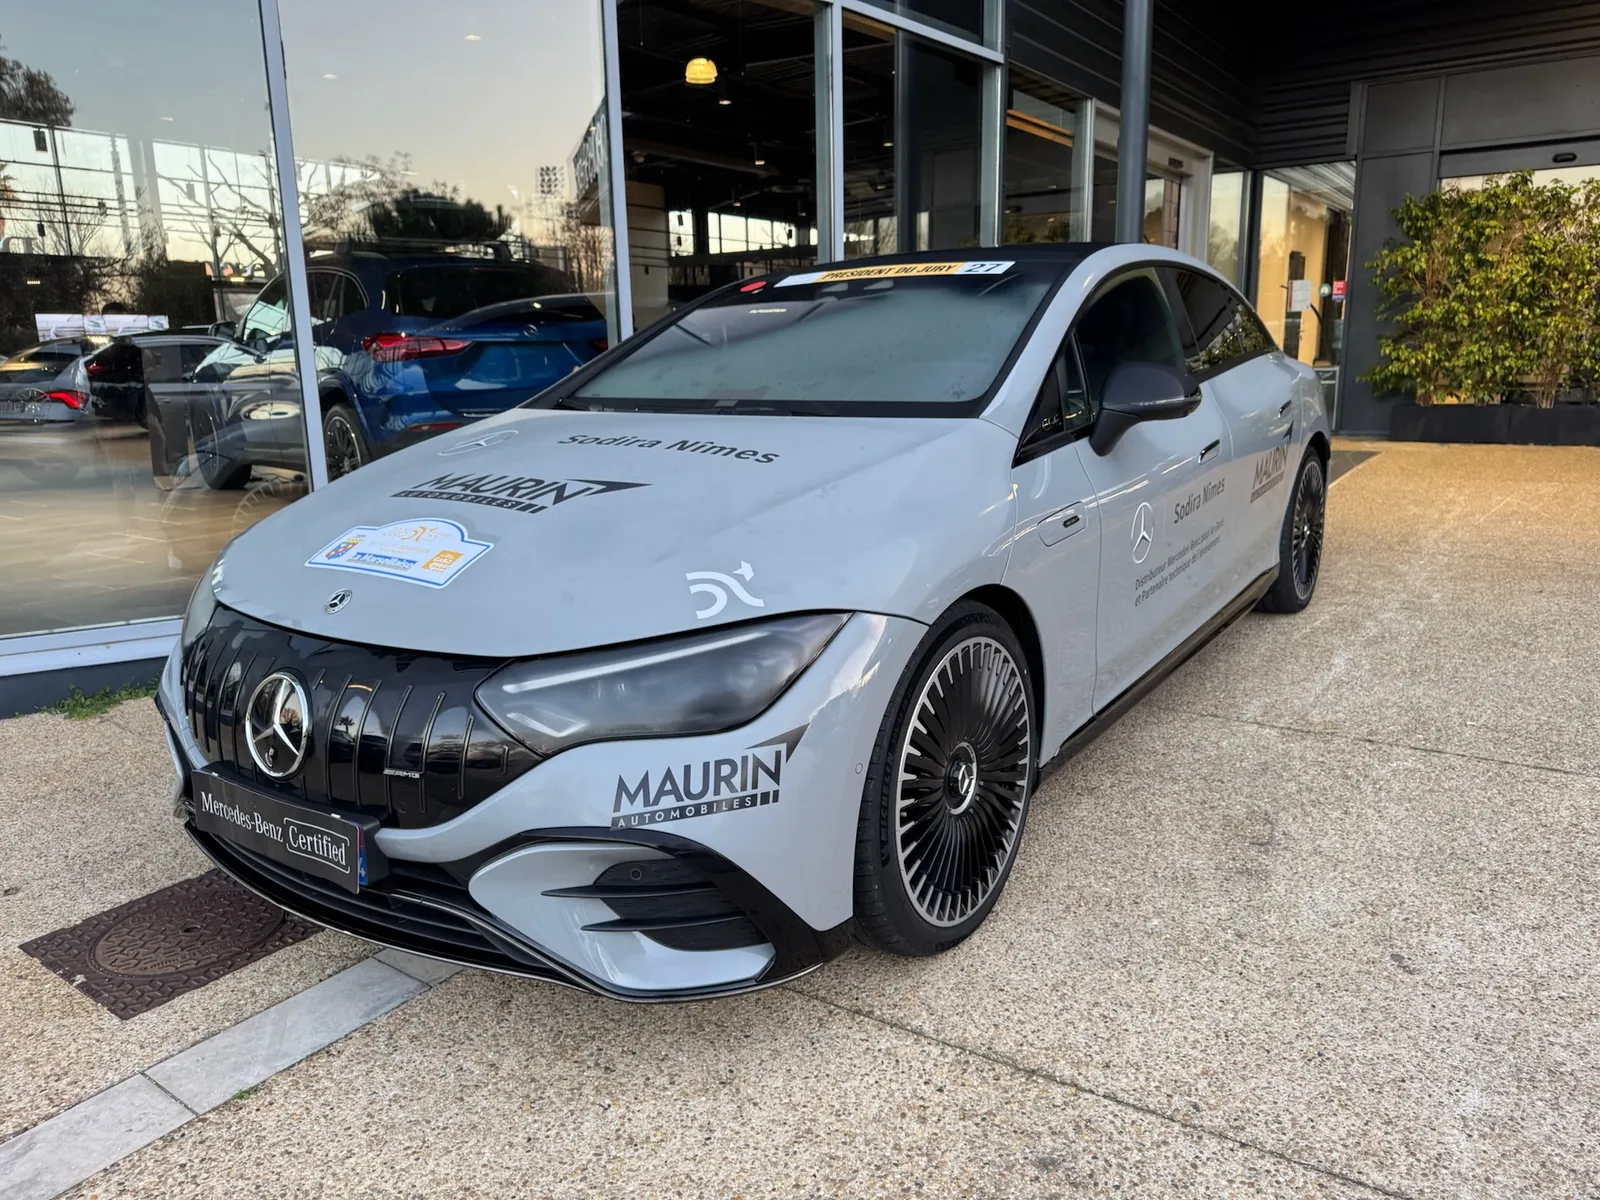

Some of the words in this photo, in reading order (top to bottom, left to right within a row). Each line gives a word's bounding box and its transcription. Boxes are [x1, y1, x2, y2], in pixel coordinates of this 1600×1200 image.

[821, 267, 897, 280] PRESIDENT
[895, 265, 918, 274] DU
[916, 264, 957, 273] JURY
[964, 263, 1005, 273] 27
[557, 434, 662, 449] Sodira
[665, 439, 780, 464] Nîmes
[1252, 441, 1289, 489] MAURIN
[398, 490, 517, 508] AUTOMOBILES
[412, 471, 597, 506] MAURIN
[1174, 491, 1201, 524] Sodira
[1202, 478, 1226, 505] Nîmes
[612, 750, 782, 814] MAURIN
[879, 753, 897, 841] MICHELIN
[201, 790, 284, 843] Mercedes-Benz
[288, 825, 347, 866] Certified
[617, 796, 752, 828] AUTOMOBILES
